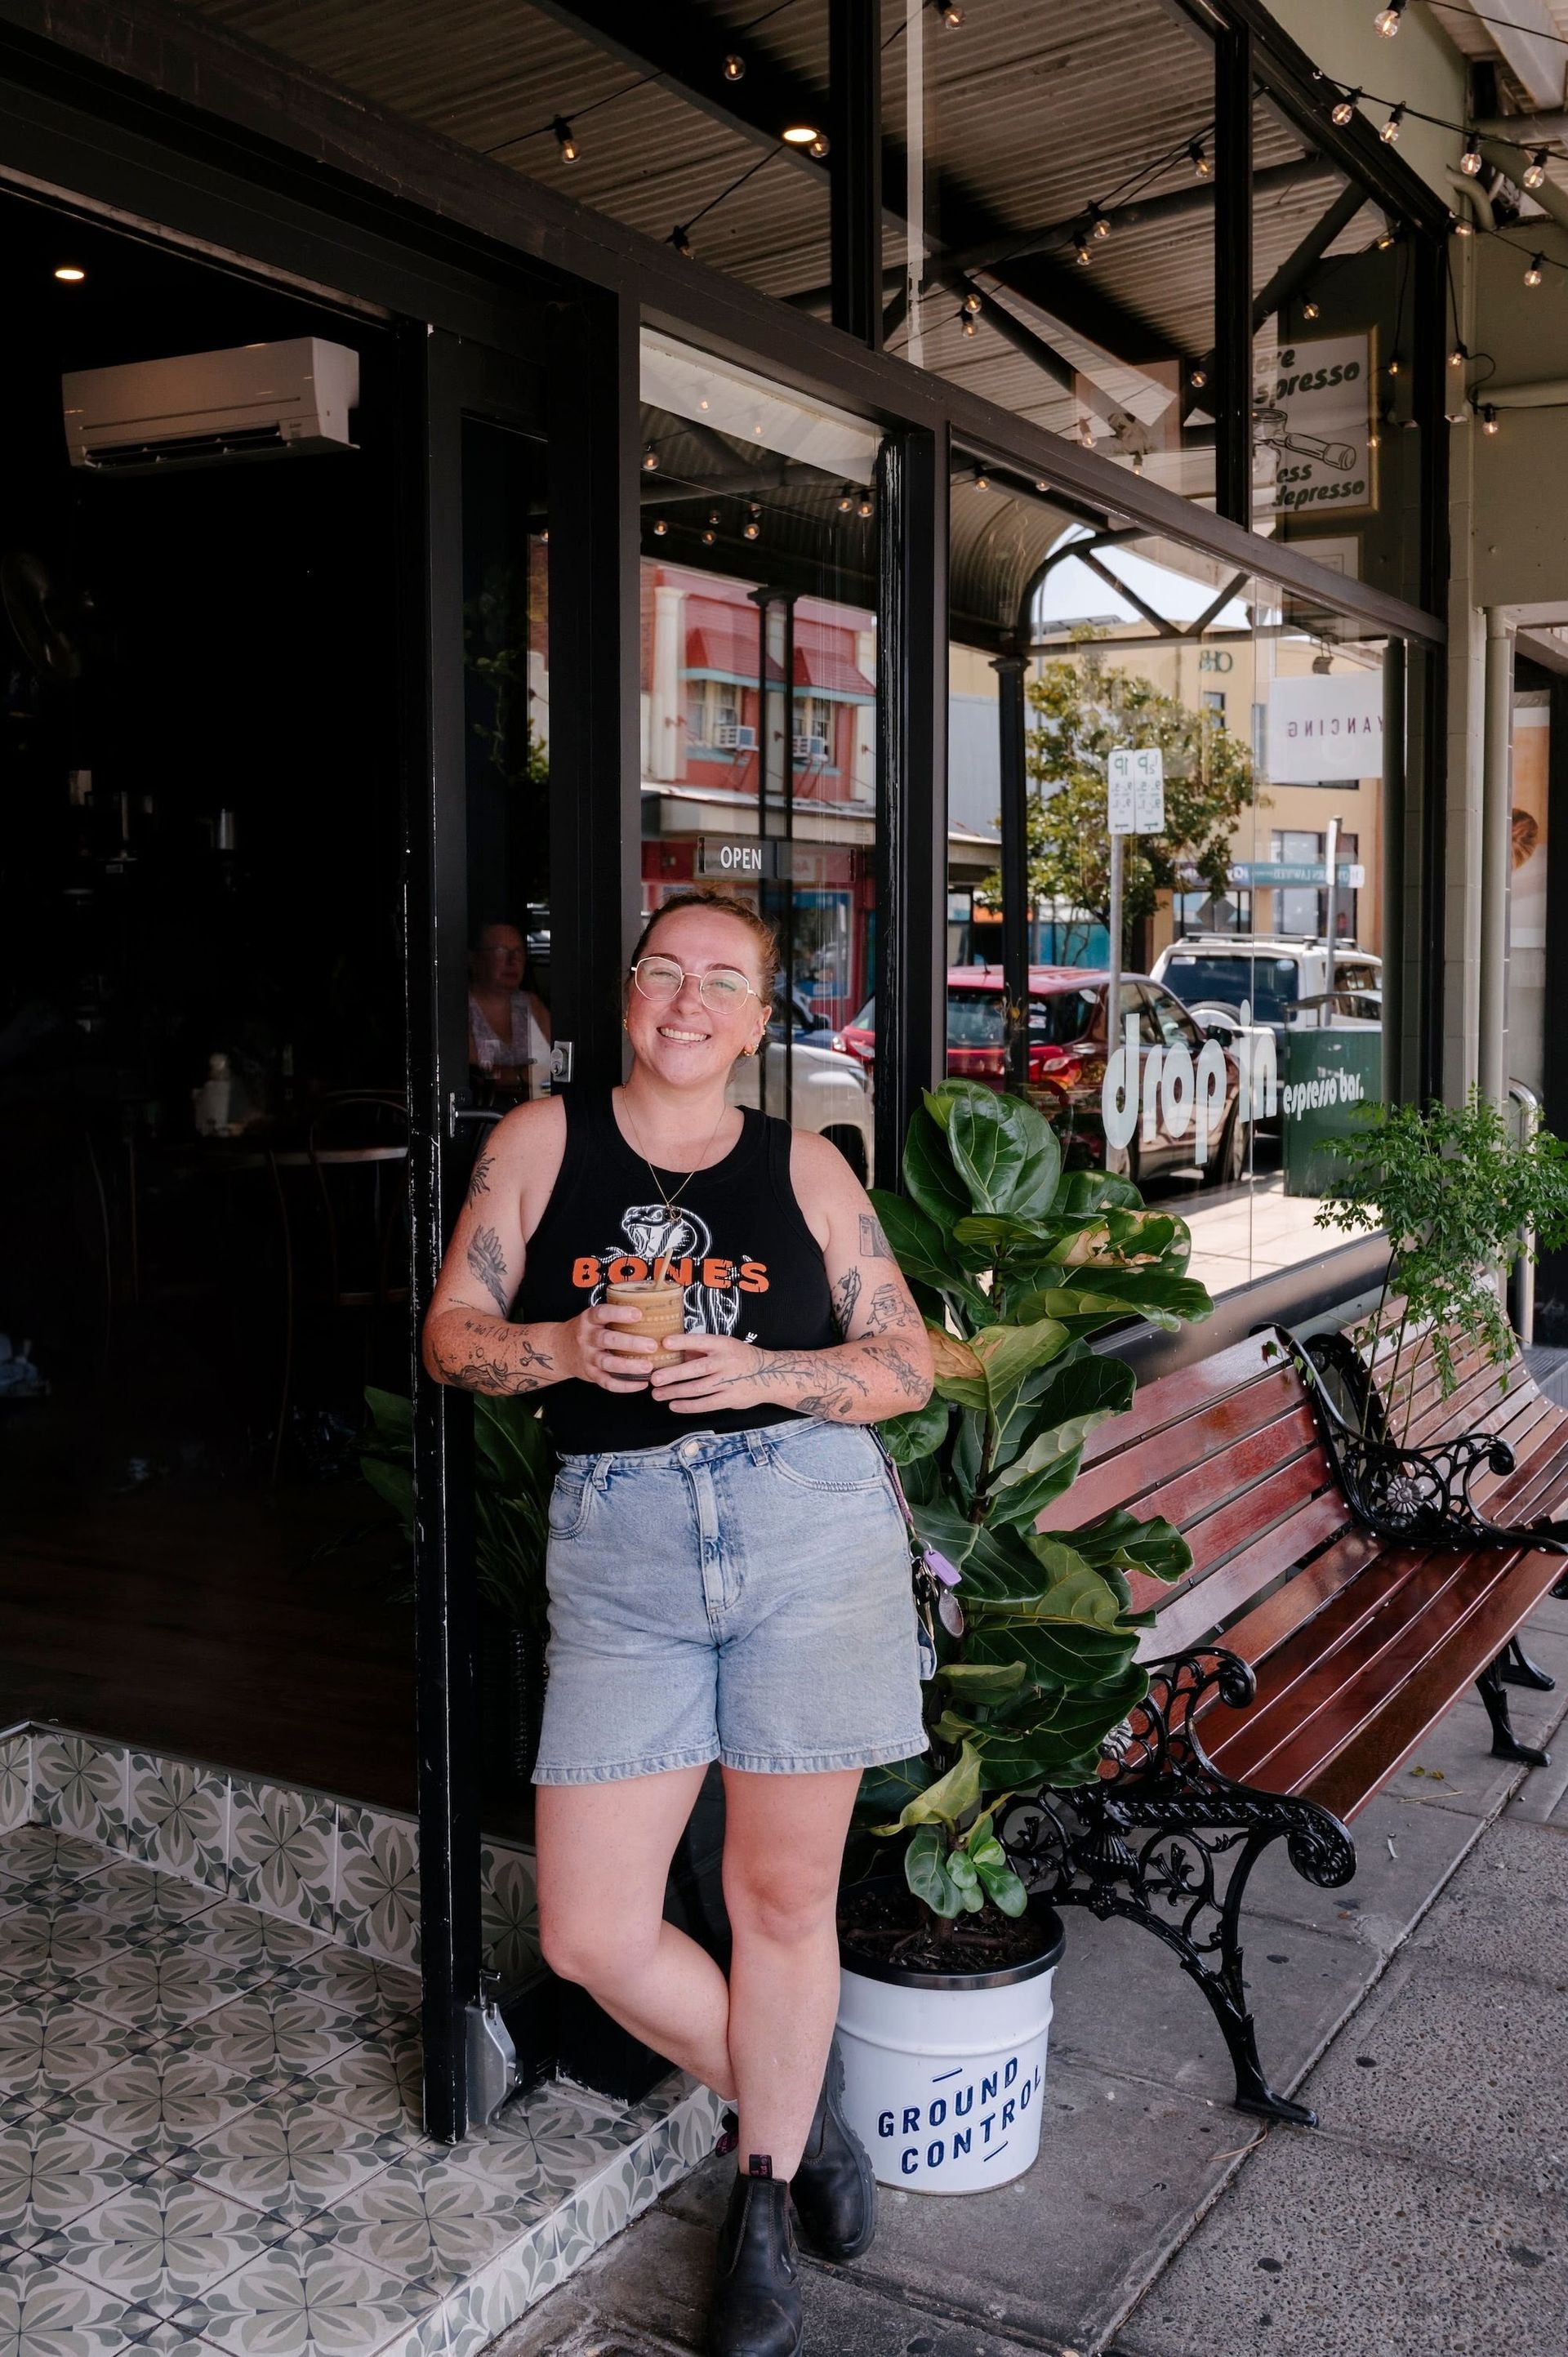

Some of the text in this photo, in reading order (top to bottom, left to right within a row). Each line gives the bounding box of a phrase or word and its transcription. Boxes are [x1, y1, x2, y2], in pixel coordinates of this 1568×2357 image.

[1255, 349, 1295, 374] ore
[1253, 362, 1361, 408] spresso
[1276, 464, 1312, 483] ess
[720, 845, 762, 870] OPEN
[1102, 999, 1365, 1165] drop in espresso bar.
[572, 1256, 769, 1293] BONES
[877, 2056, 1018, 2138] GROUND
[900, 2065, 1041, 2174] CONTROL
